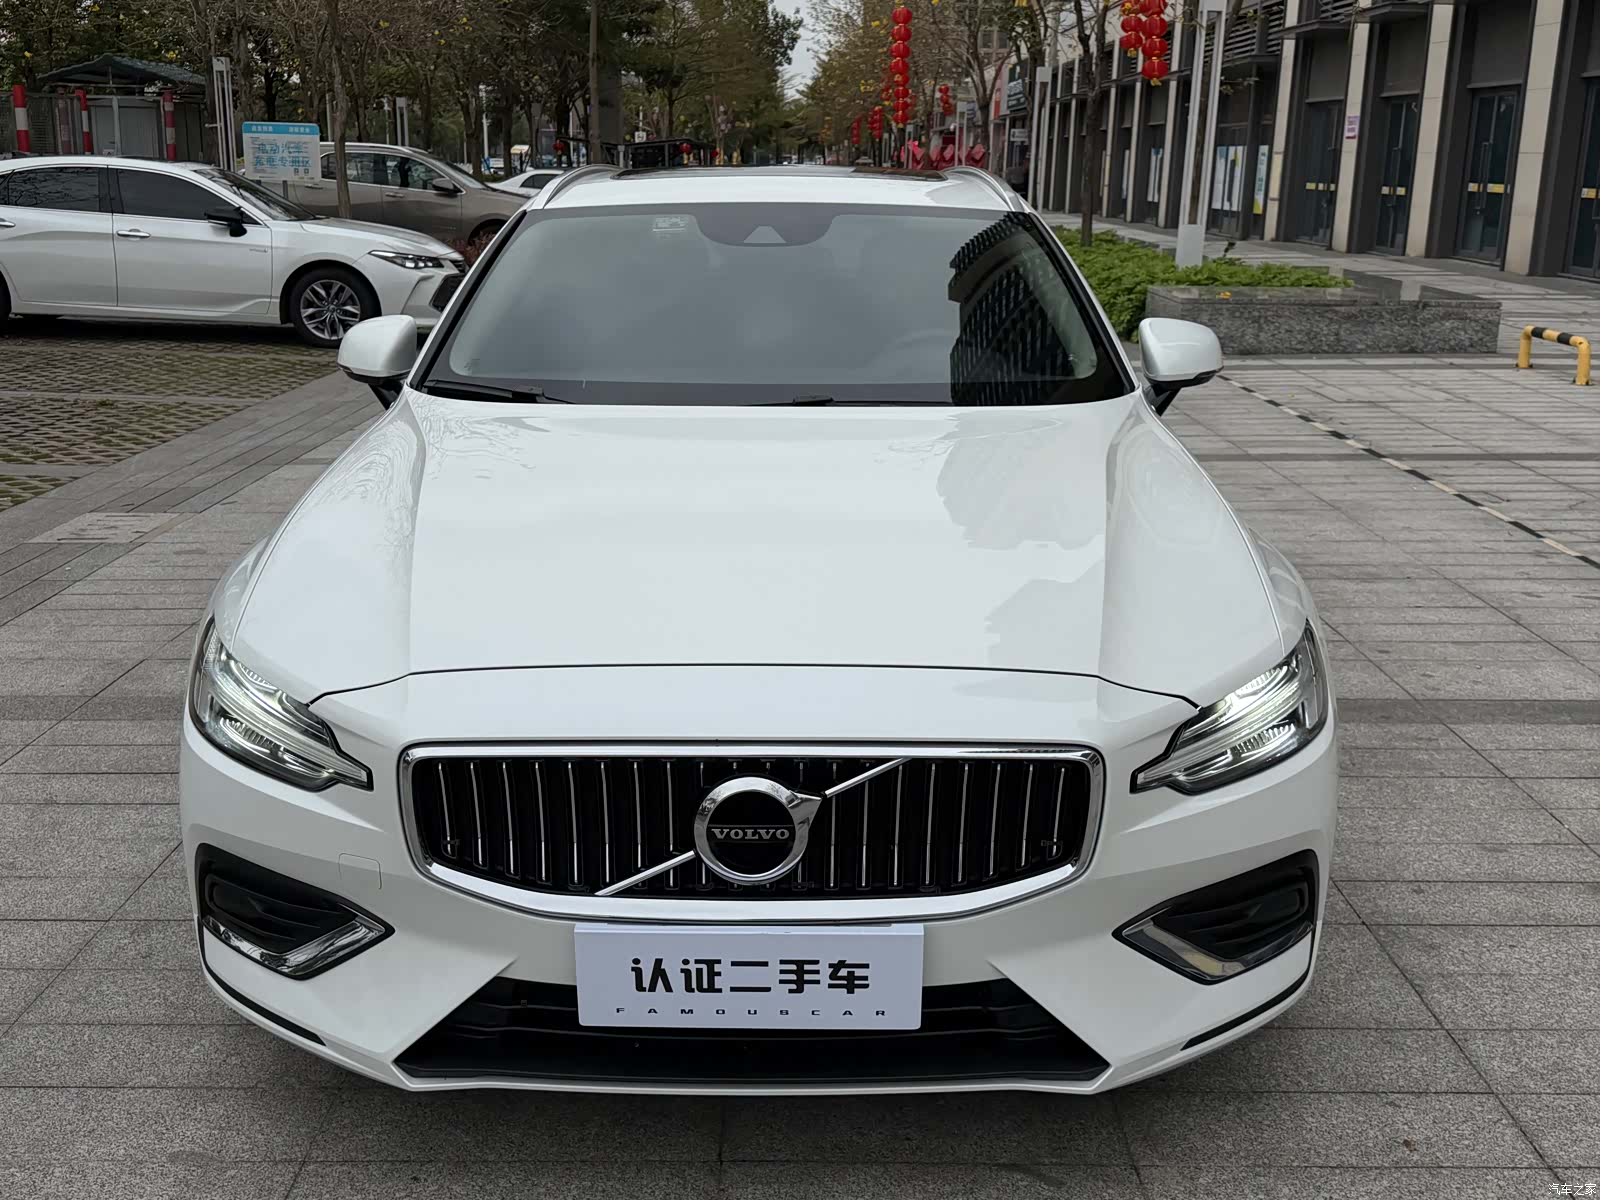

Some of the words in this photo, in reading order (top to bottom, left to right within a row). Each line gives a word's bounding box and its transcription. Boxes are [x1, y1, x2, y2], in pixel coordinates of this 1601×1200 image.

[257, 142, 304, 154] 电动汽车
[711, 828, 790, 840] VOLVO
[630, 957, 870, 994] 认证二手车
